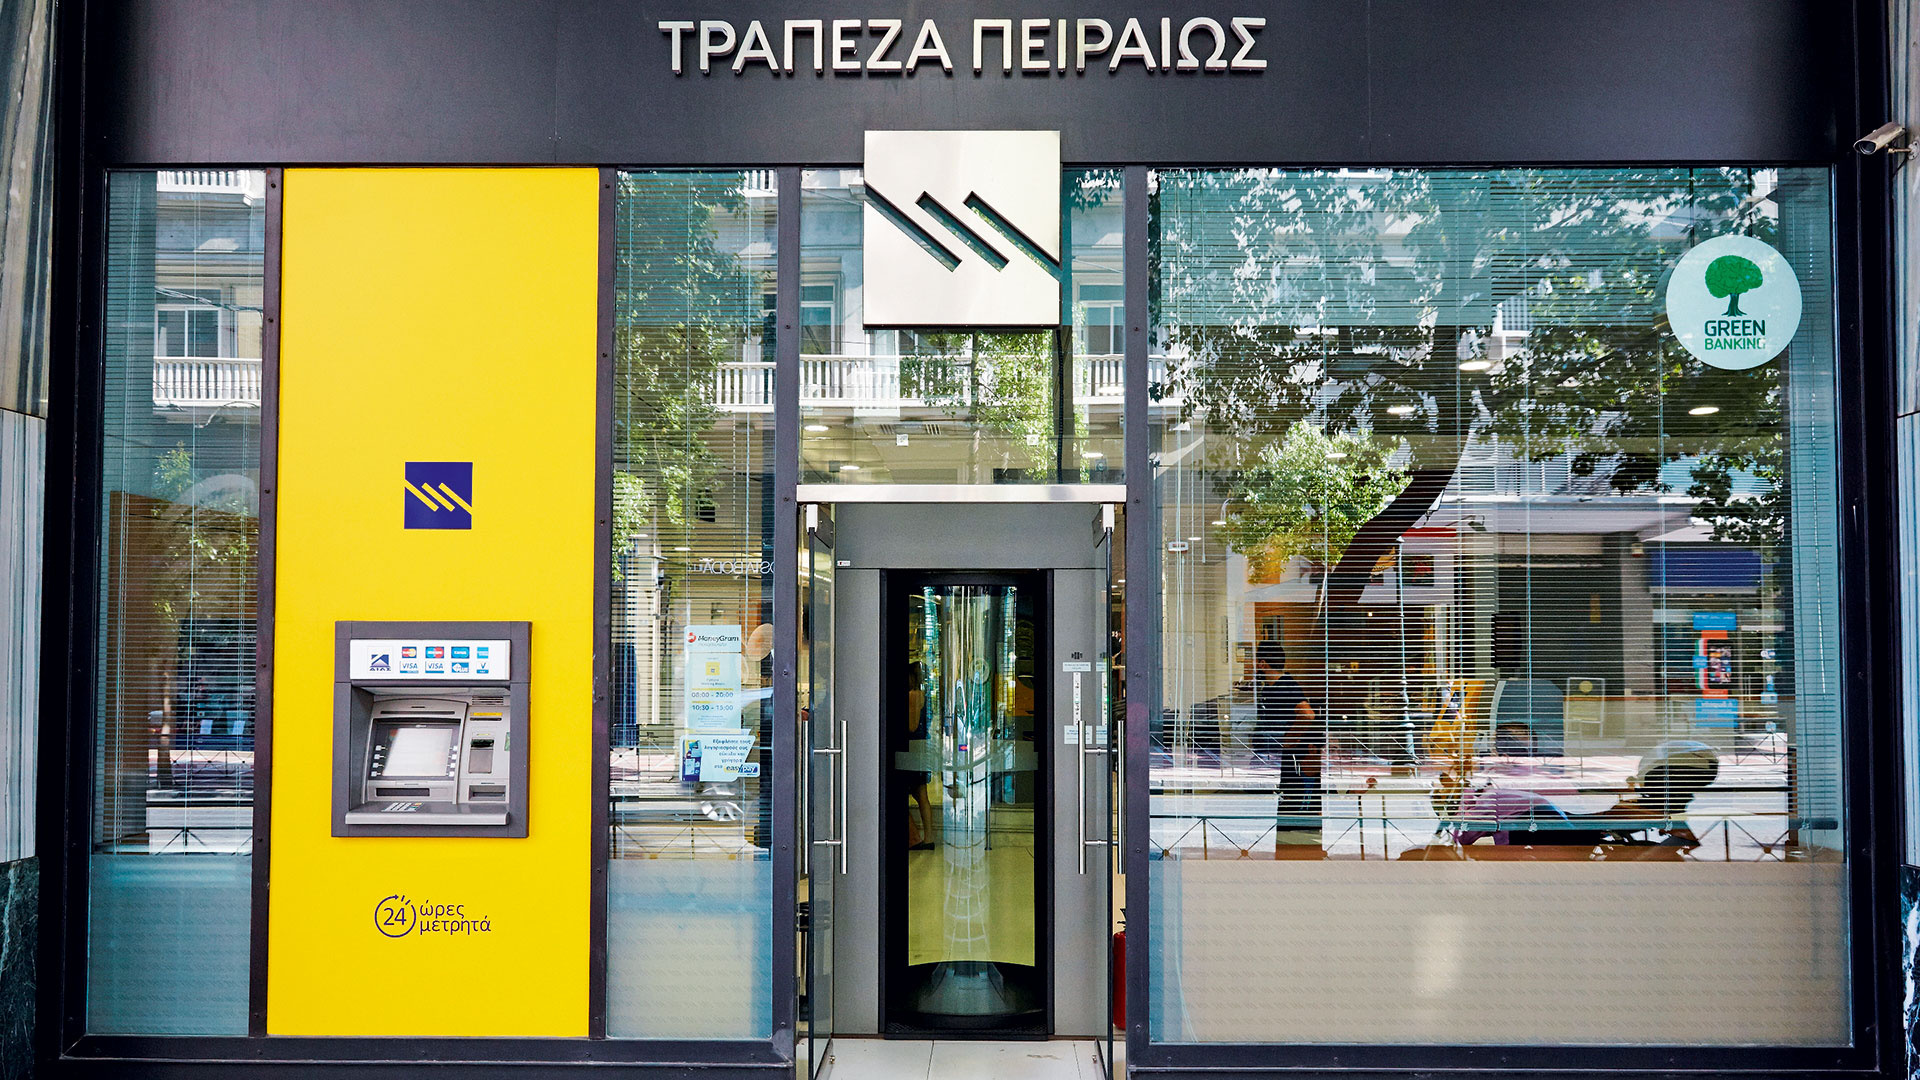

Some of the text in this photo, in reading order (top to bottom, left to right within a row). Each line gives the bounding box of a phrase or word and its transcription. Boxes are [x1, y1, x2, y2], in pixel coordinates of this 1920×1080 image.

[658, 16, 1267, 76] ΤΡΑΠΕΖΑ ΠΕΙΡΑΙΩΣ
[1704, 319, 1766, 337] GREEN
[1704, 337, 1766, 350] BANKING
[697, 635, 740, 643] MoneyGram
[383, 907, 408, 926] 24
[419, 899, 465, 919] ώρες
[419, 915, 492, 936] μετρητά
